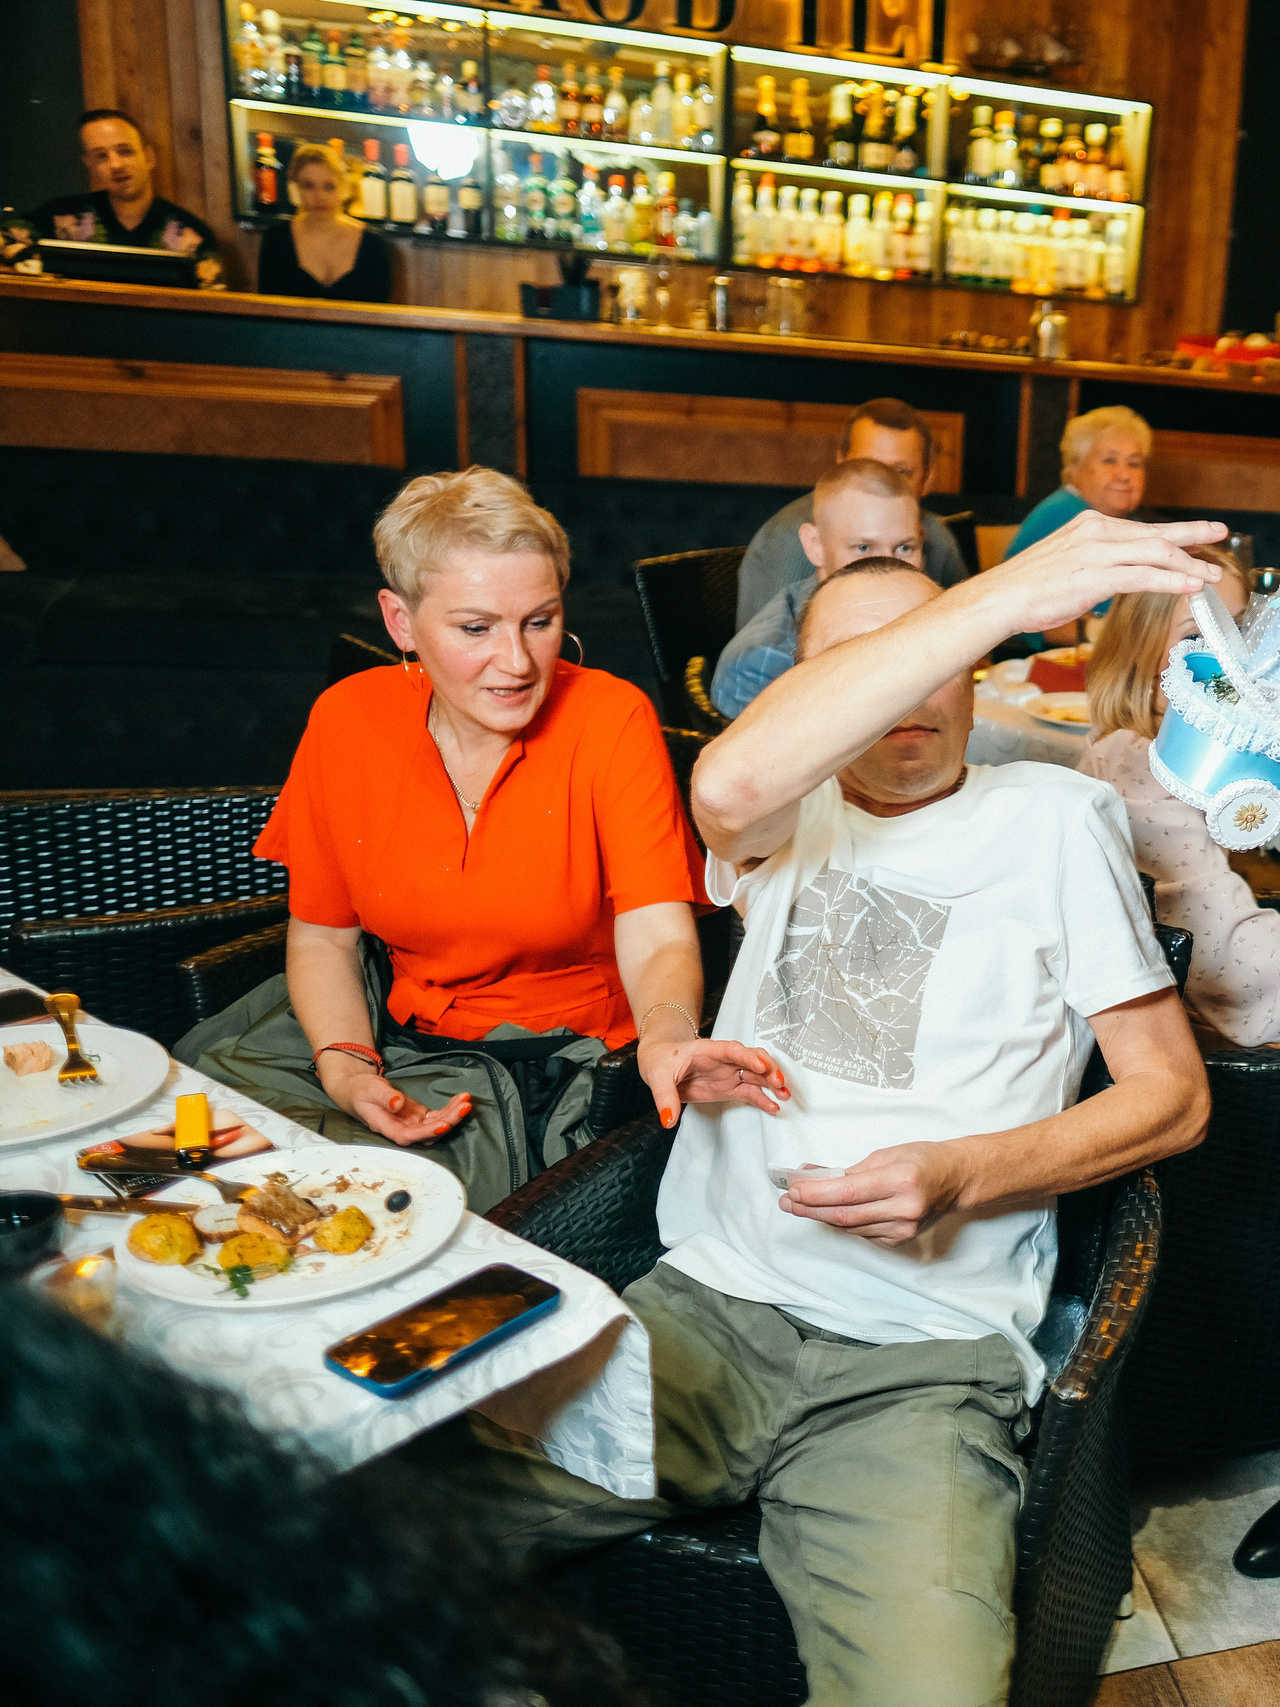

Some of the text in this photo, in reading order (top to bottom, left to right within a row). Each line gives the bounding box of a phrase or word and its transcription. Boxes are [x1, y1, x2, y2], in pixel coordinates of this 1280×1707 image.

[774, 1034, 876, 1084] BUT NOT EVERYONE SEES IT.
[825, 1055, 841, 1065] HAS
